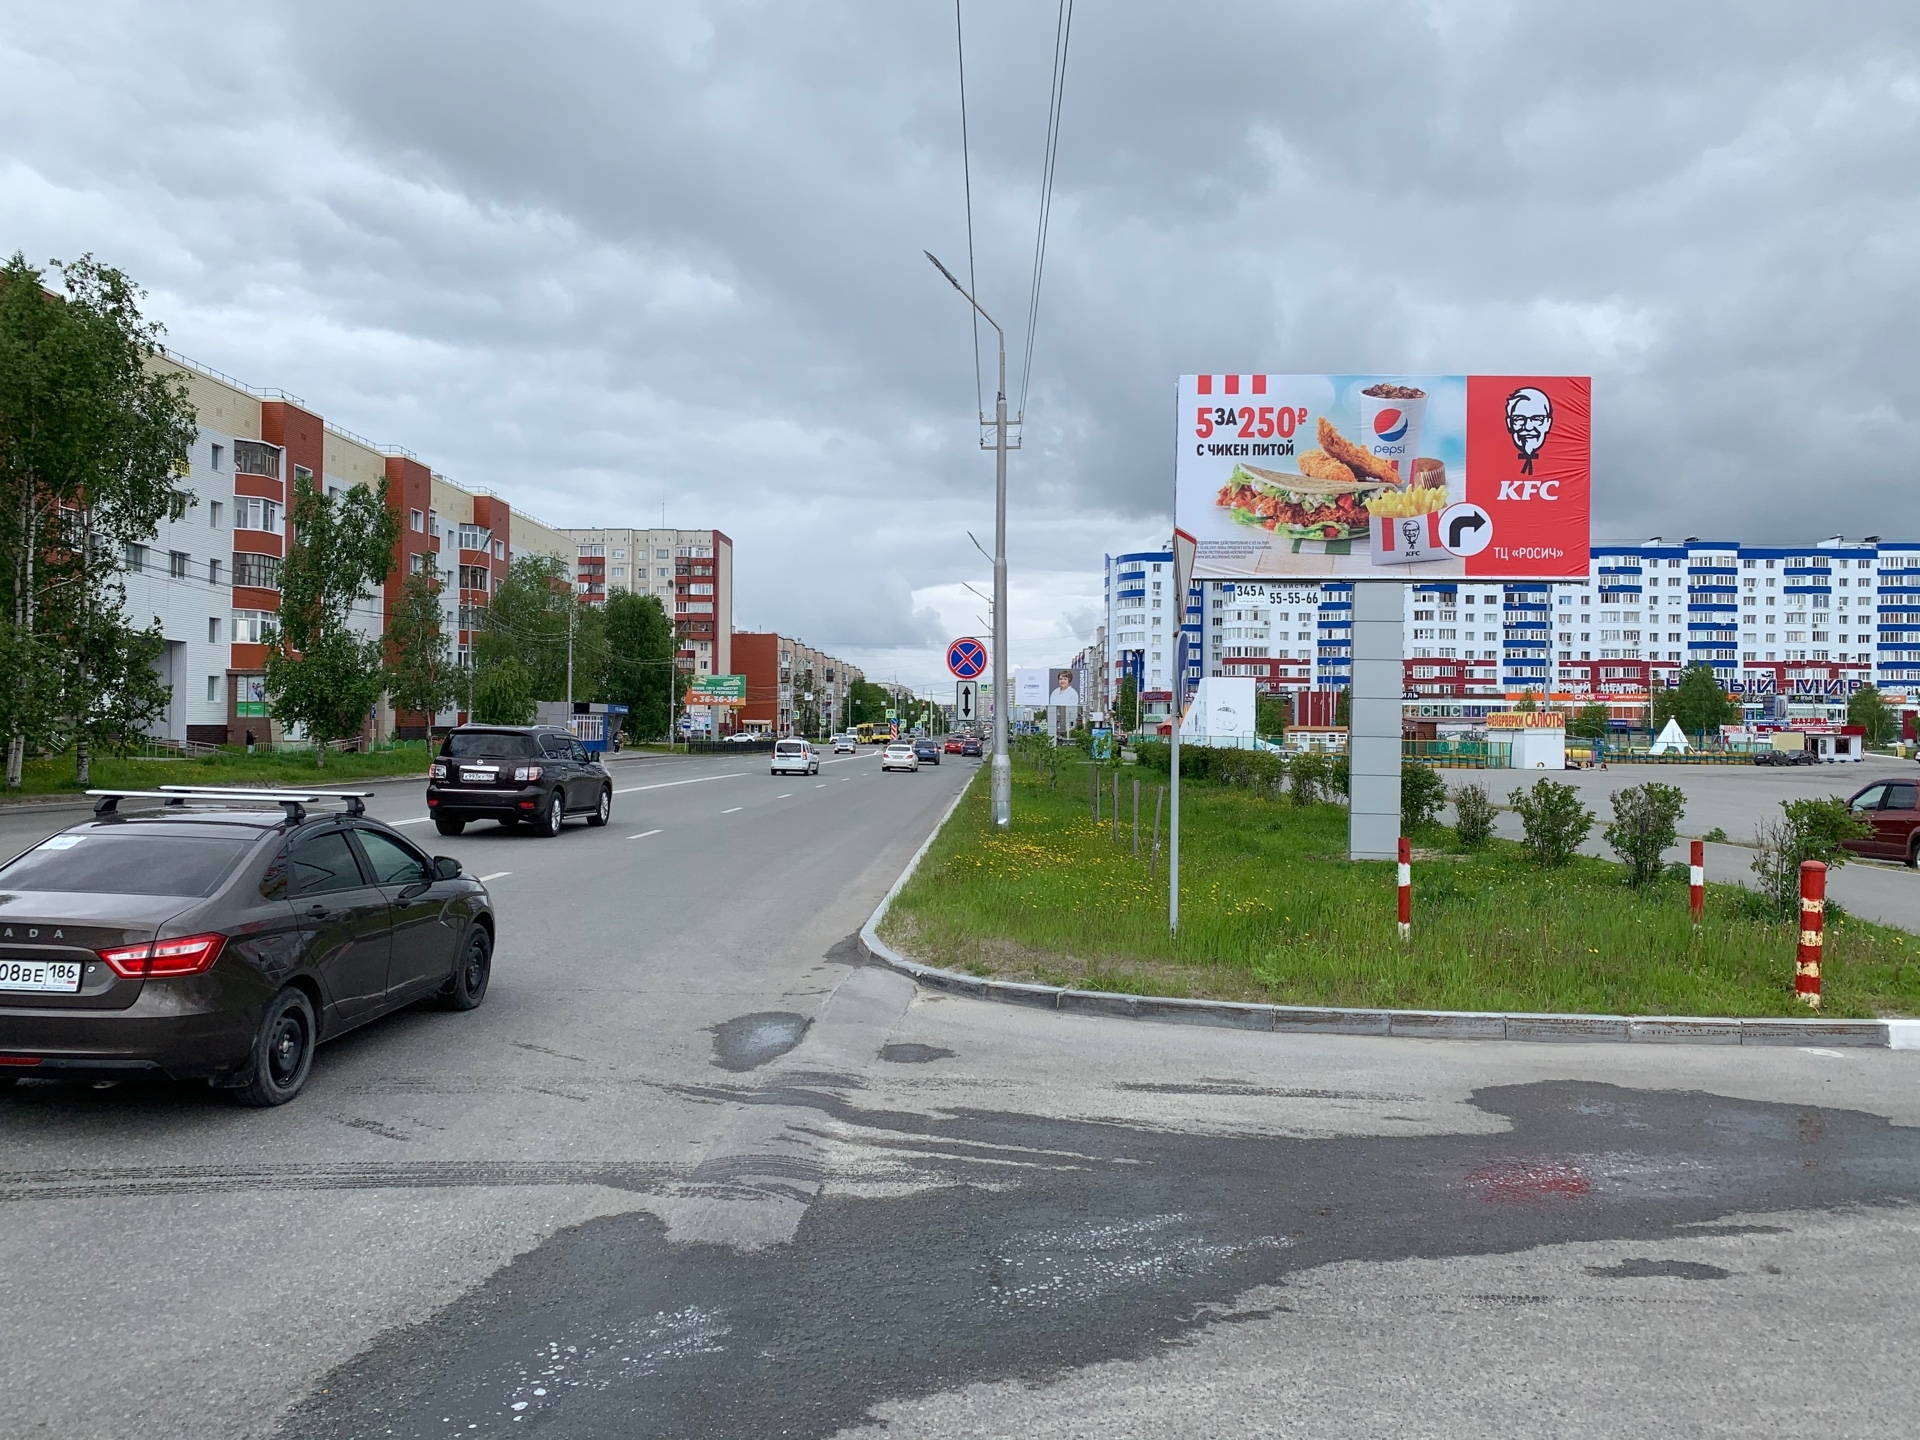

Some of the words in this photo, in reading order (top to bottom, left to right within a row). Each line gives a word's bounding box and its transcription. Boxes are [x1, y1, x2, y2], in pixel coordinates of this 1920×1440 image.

[1196, 444, 1205, 456] С
[1207, 444, 1249, 456] ЧИКЕН
[1252, 439, 1294, 456] ПИТОЙ
[1374, 445, 1406, 456] pepsi
[1496, 480, 1560, 501] KFC
[1493, 547, 1509, 561] ТЦ
[1511, 547, 1564, 559] «РОСИЧ»
[1269, 592, 1319, 604] 55-55-66
[1666, 673, 1778, 694] НВЫЙ
[1795, 679, 1864, 695] МИР
[699, 695, 738, 703] 36-36-36
[1421, 705, 1461, 717] CHIC
[1487, 714, 1524, 728] ФЕЙЕРВЕРКИ
[1525, 712, 1565, 728] САЛЮТЫ
[1791, 717, 1828, 726] ШАУРМА
[49, 964, 75, 979] 186
